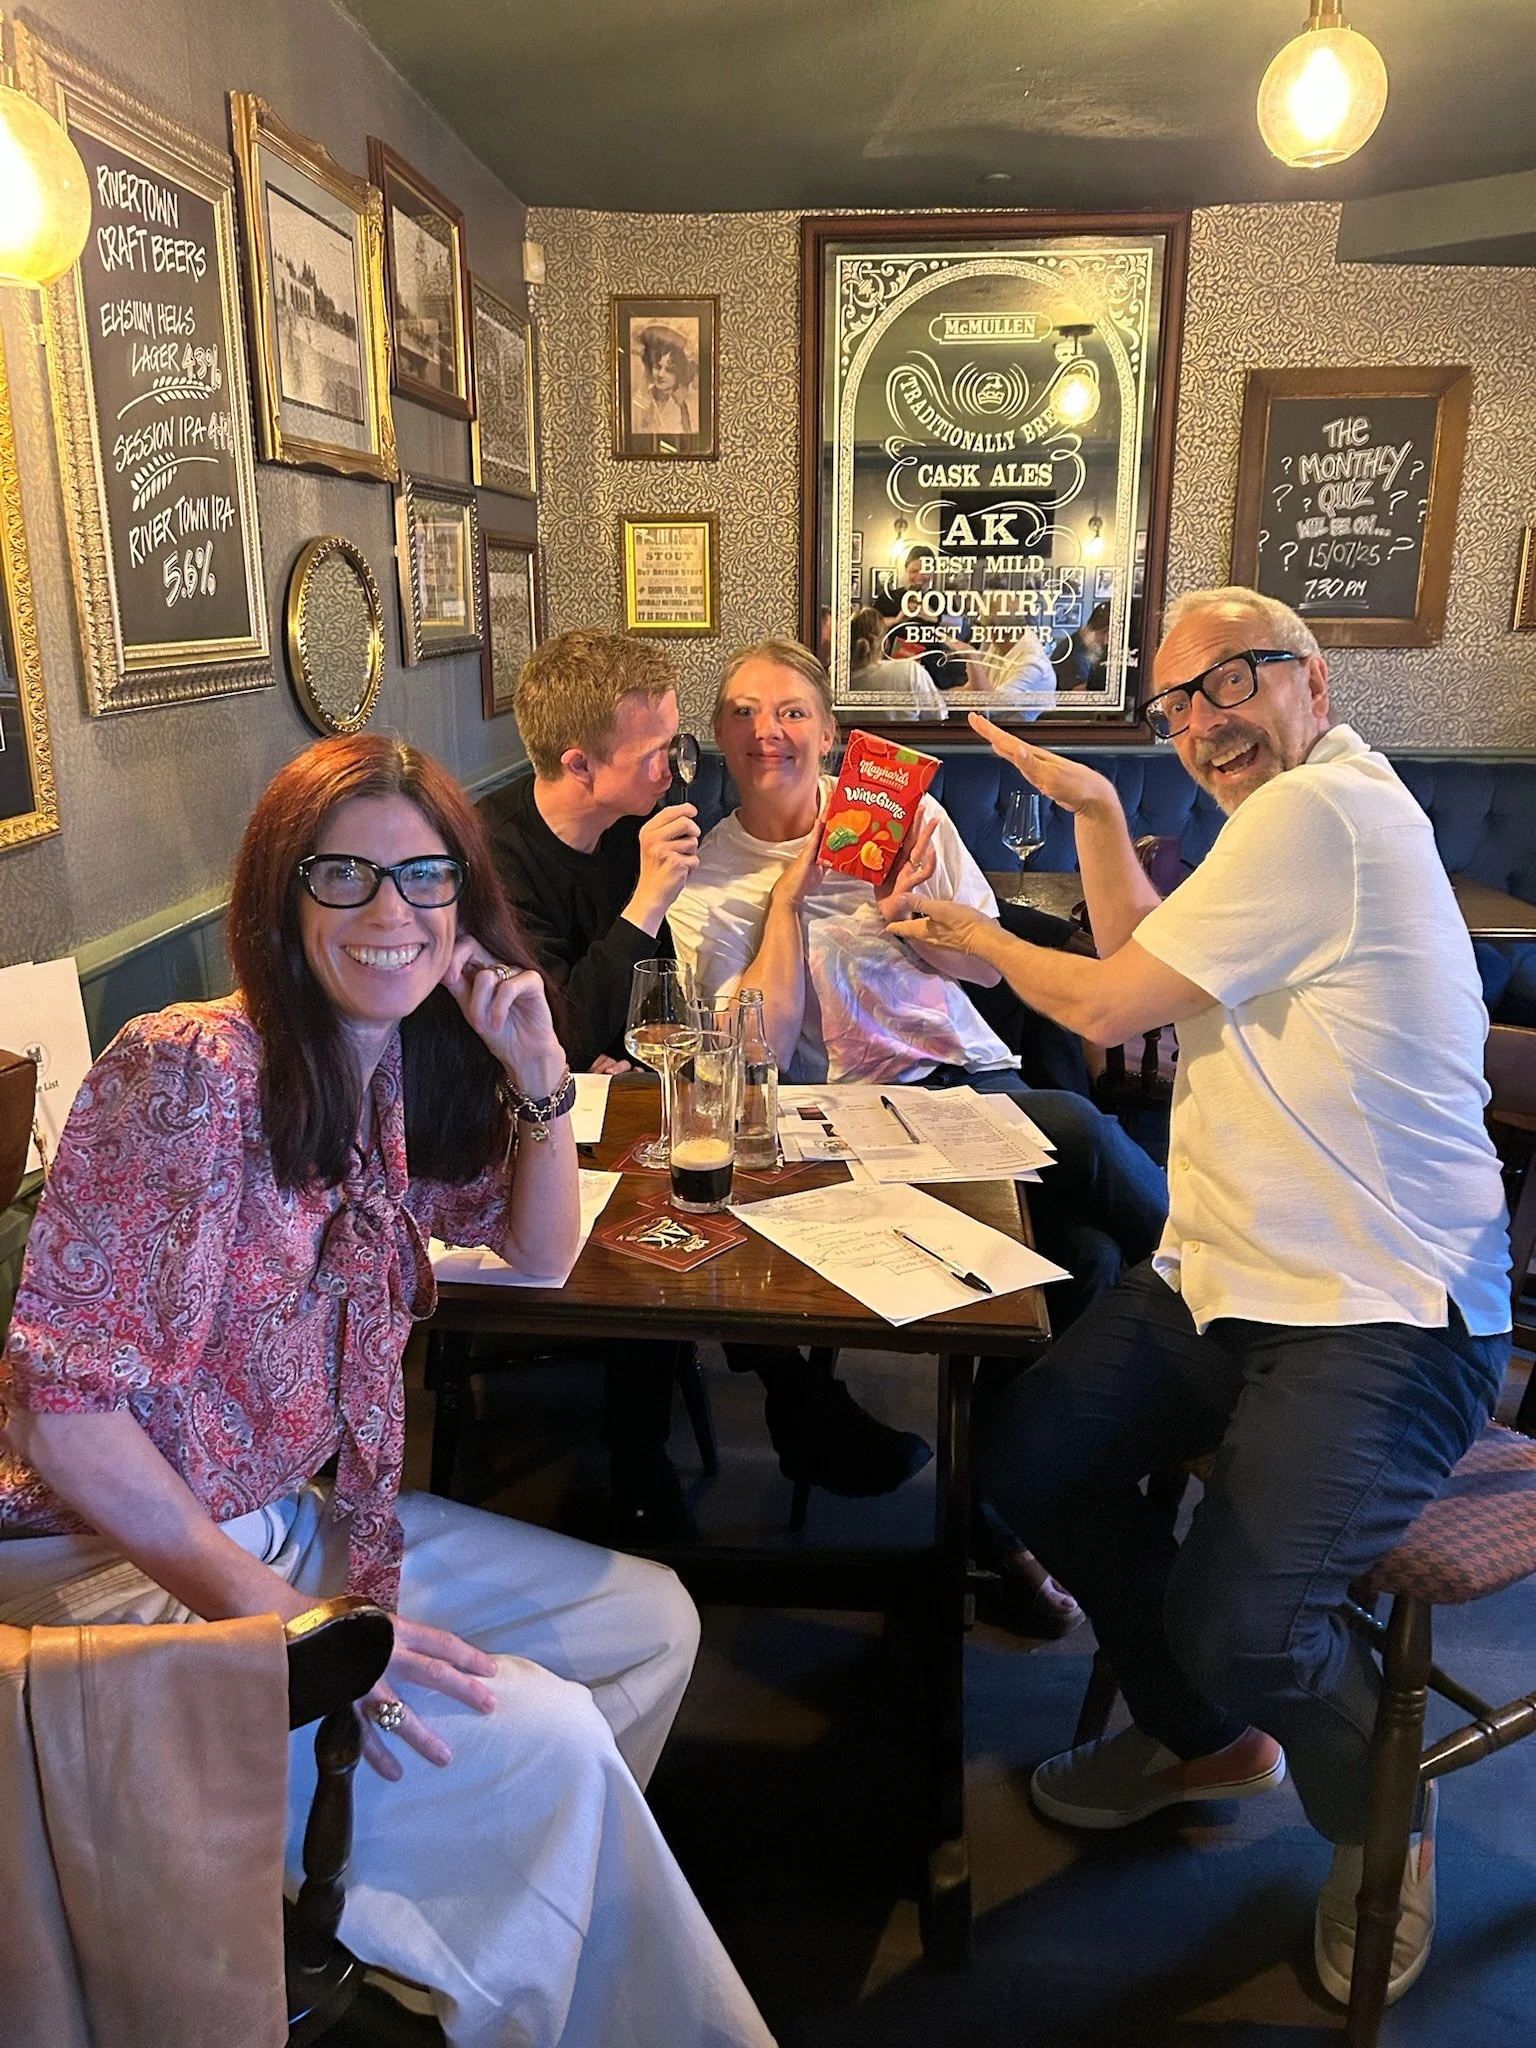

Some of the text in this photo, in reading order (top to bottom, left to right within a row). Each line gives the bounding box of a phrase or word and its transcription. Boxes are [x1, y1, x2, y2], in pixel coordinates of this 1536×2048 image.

[97, 165, 179, 229] RIVERTOWN
[97, 225, 207, 283] CRAFT BEERS
[100, 299, 196, 339] ELYSIUM HELLS
[944, 317, 1036, 335] McMULLEN
[131, 342, 182, 377] LAGER
[901, 376, 1058, 453] TRADITIONALLY BRE
[112, 415, 175, 473] SESSION
[179, 415, 208, 447] IPA
[917, 463, 1053, 488] CASK ALES
[1299, 440, 1414, 491] MONTHLY
[128, 494, 236, 569] RIVER TOWN IPA
[941, 513, 1019, 547] AK
[646, 552, 693, 561] STOUT
[918, 555, 1045, 574] BEST MILD
[1307, 539, 1381, 570] 15/07/25
[163, 540, 216, 608] 5.6%
[1304, 578, 1368, 599] 7.30 PM
[900, 589, 1063, 618] COUNTRY
[904, 625, 1054, 643] BEST BITTER
[859, 760, 909, 787] Maynards
[44, 1080, 59, 1092] List
